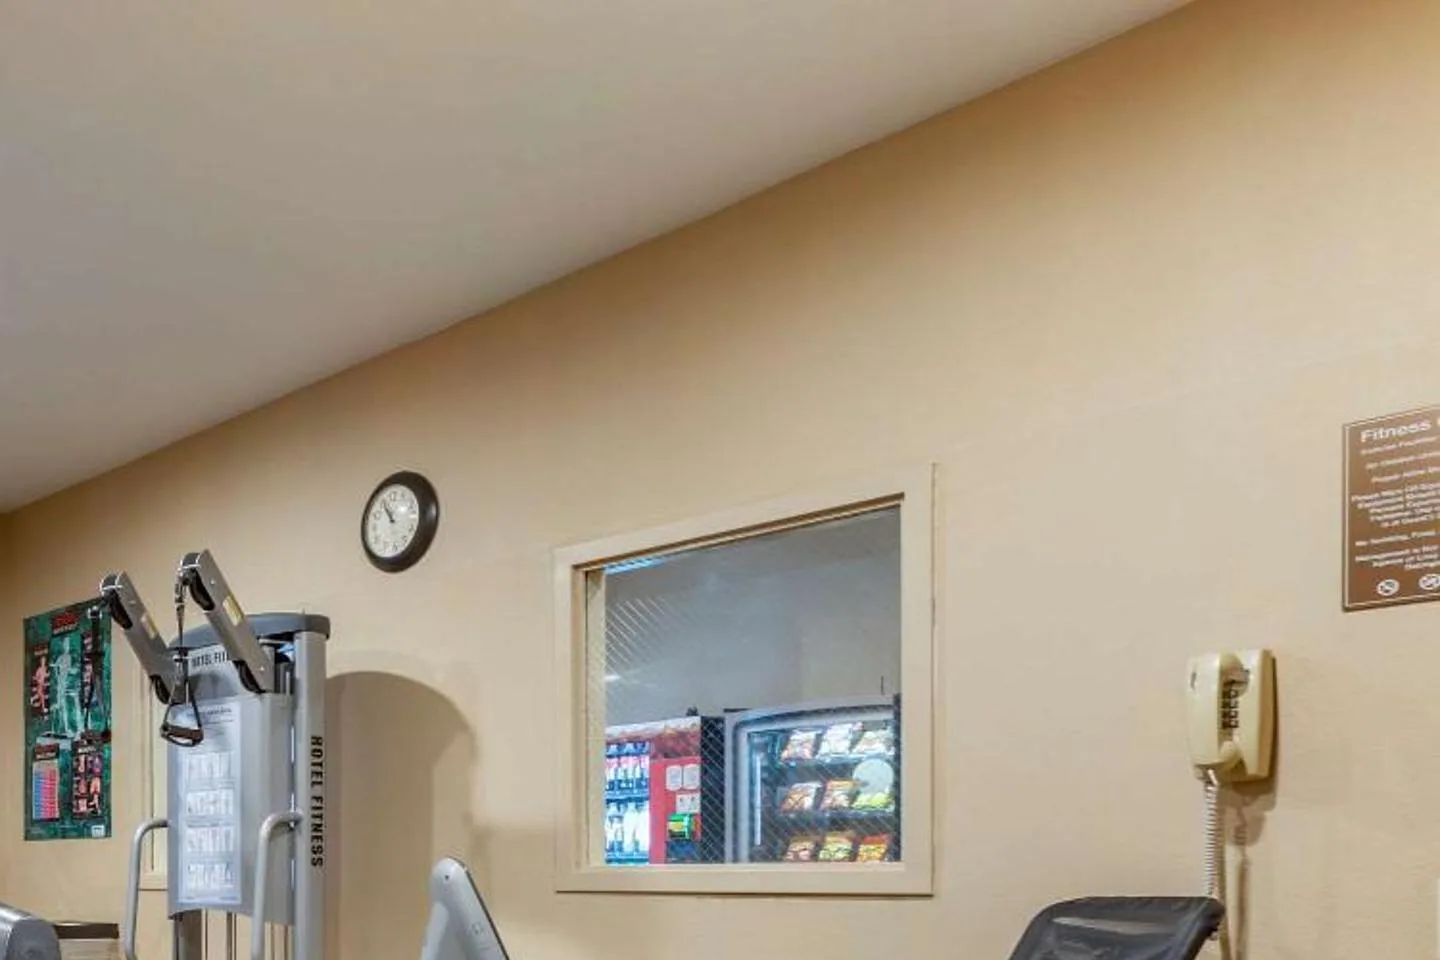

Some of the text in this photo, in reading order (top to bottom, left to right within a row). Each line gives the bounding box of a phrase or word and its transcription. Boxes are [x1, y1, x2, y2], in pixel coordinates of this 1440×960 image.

[1360, 419, 1432, 443] Fitness
[310, 735, 324, 868] HOTEL FITNESS
